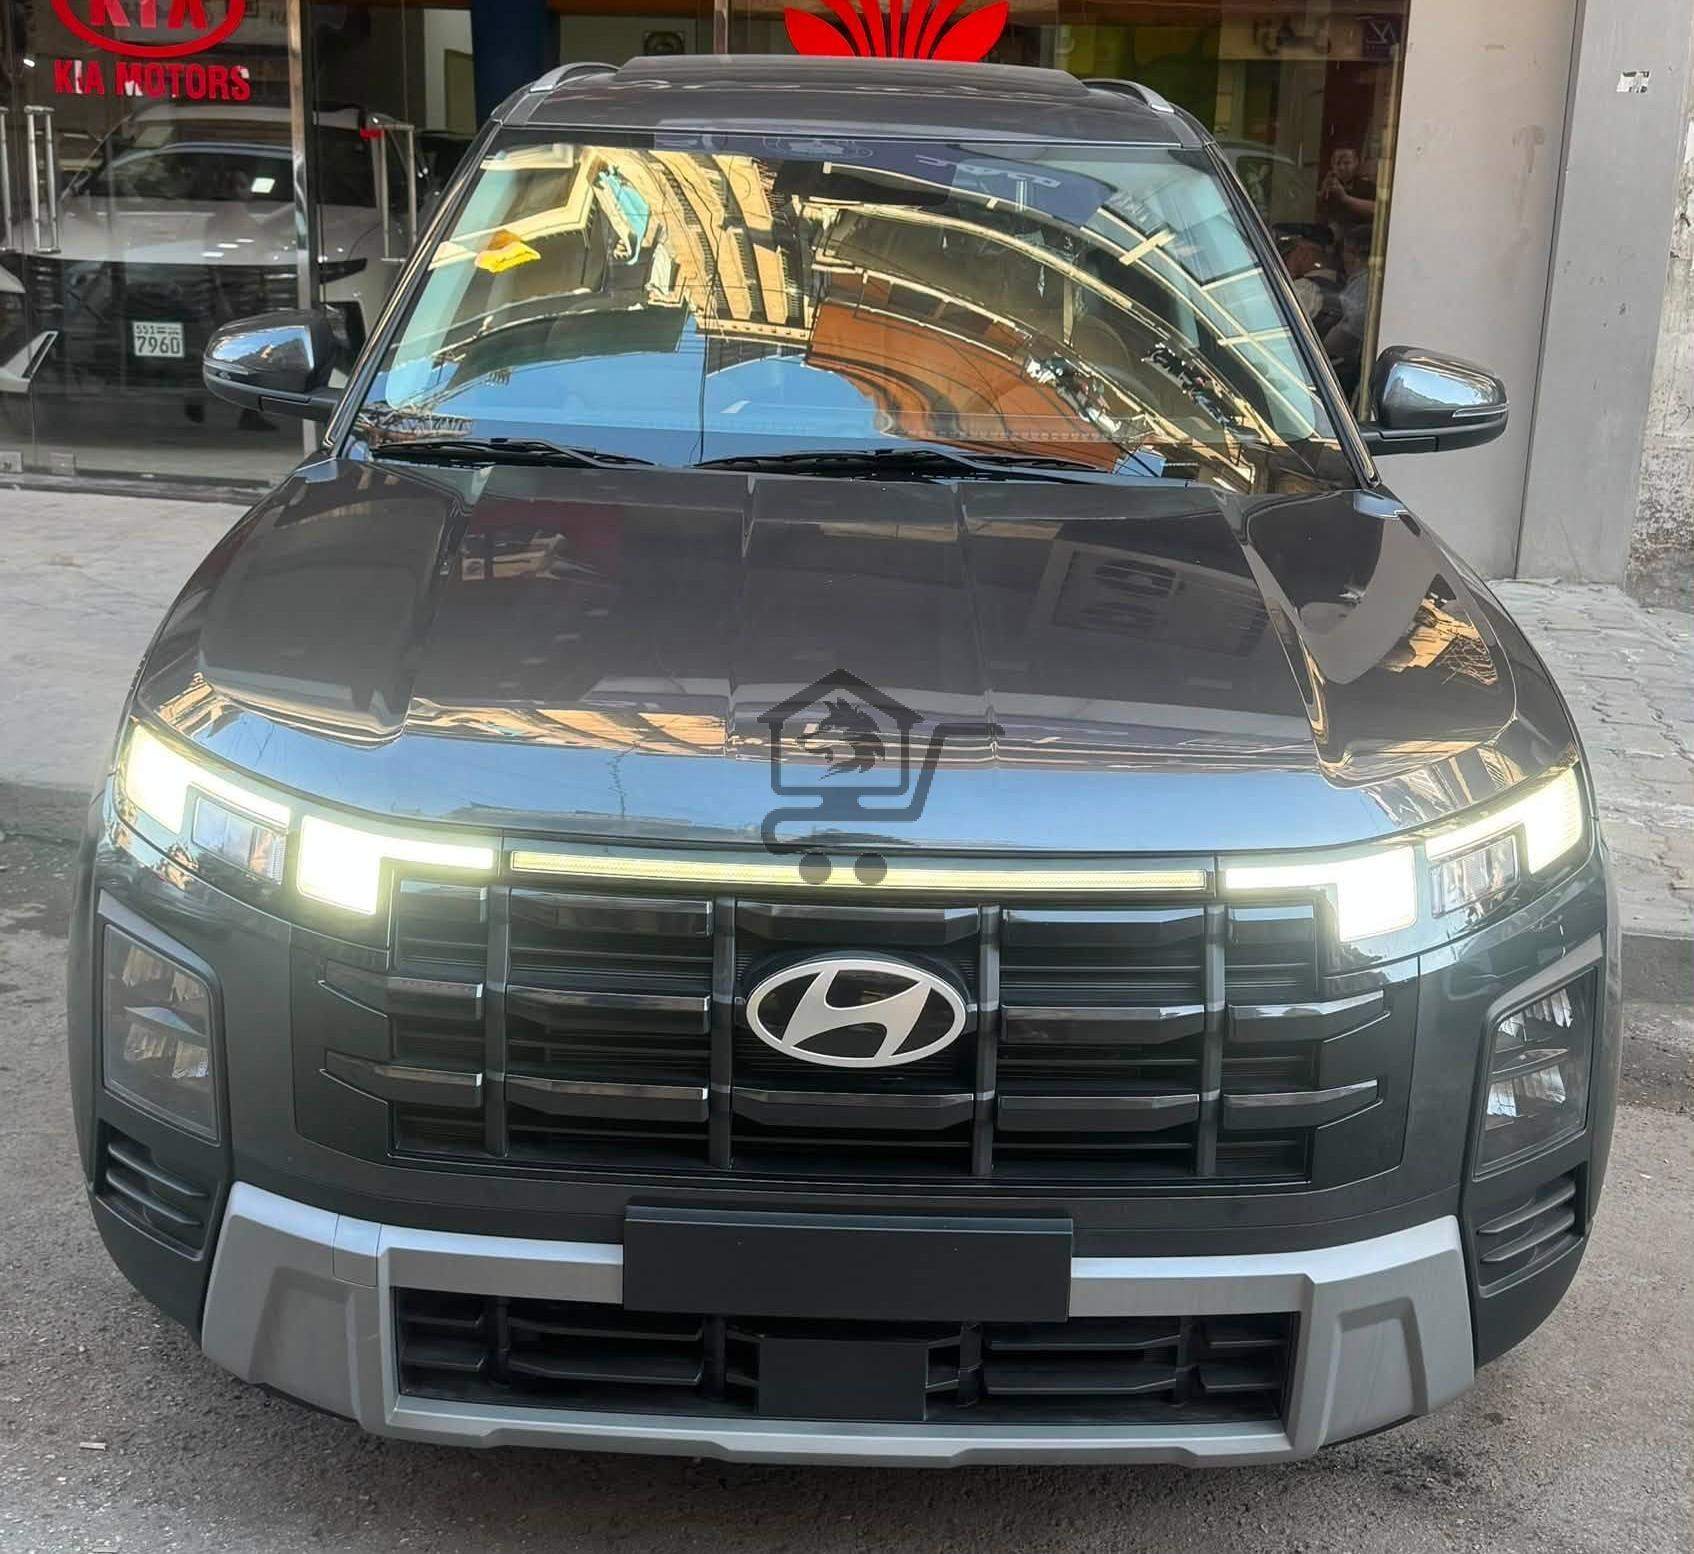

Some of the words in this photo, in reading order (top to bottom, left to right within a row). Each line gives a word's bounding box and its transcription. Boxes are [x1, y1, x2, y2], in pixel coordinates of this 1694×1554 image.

[54, 60, 105, 96] KIA
[116, 61, 250, 101] MOTORS
[136, 335, 181, 354] 7960
